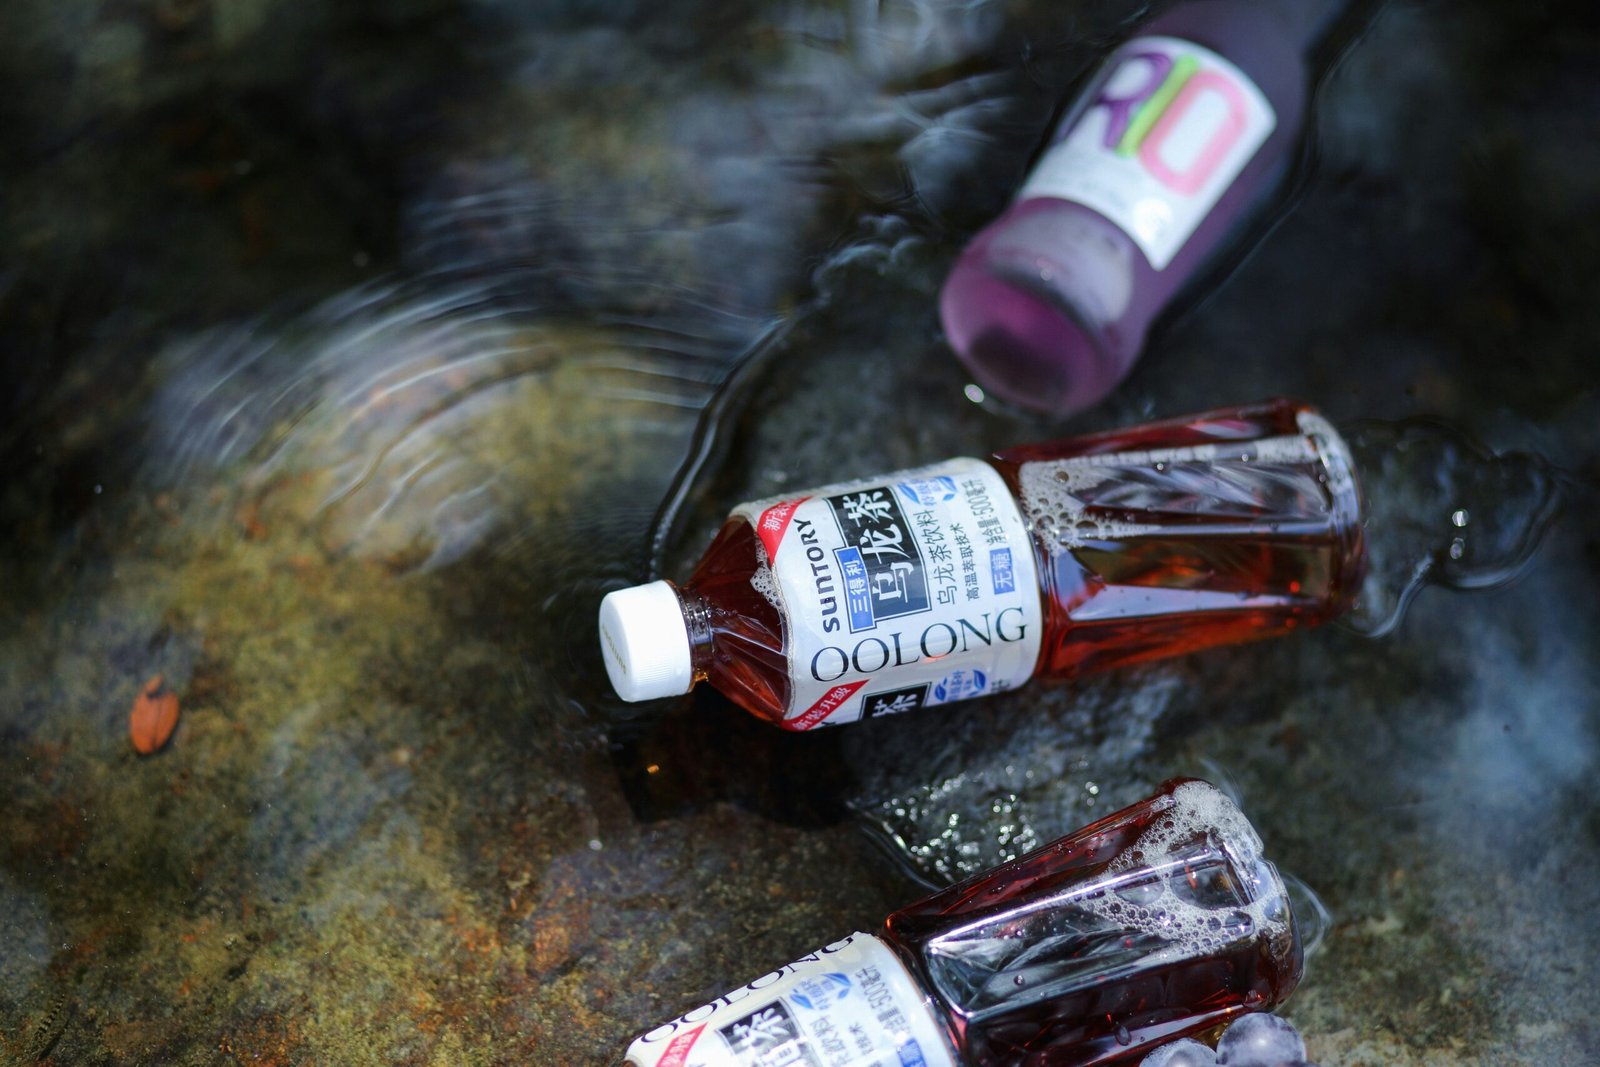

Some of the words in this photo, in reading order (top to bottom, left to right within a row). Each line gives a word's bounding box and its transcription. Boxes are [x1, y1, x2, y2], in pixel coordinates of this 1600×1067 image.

[1055, 50, 1248, 198] RIO
[842, 491, 915, 604] 乌龙茶
[844, 559, 869, 614] 三得利
[912, 508, 958, 605] 乌龙茶饮料
[949, 522, 981, 602] 高温萃取技术
[991, 550, 1013, 590] 无糖
[810, 606, 1029, 682] OOLONG
